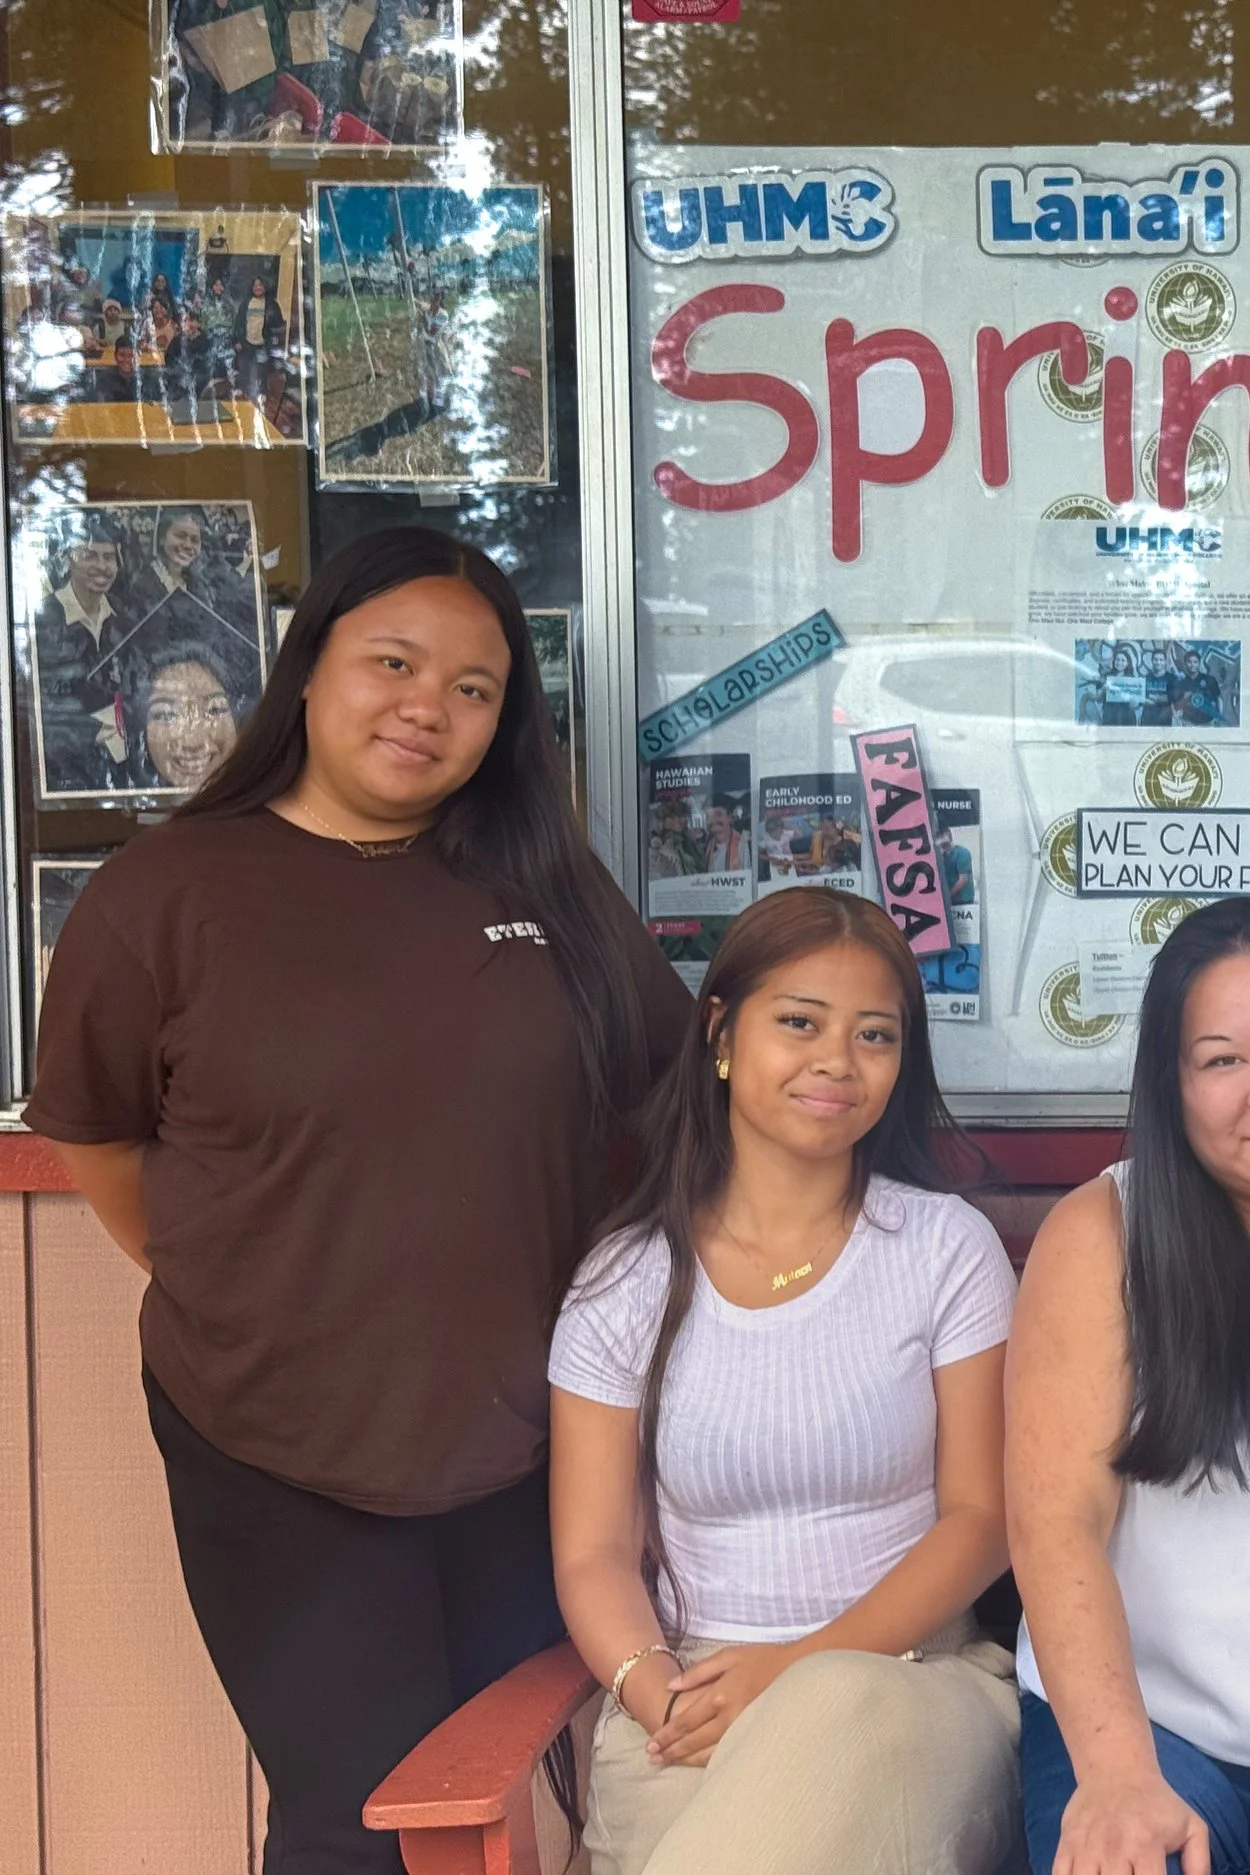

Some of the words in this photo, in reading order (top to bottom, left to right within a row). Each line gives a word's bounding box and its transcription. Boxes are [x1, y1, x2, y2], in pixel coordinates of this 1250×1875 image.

[643, 180, 888, 250] UHMC
[1095, 526, 1223, 552] UHMC
[655, 765, 714, 781] HAWAIIAN
[655, 777, 701, 790] STUDIES
[765, 787, 800, 798] EARLY
[765, 795, 833, 808] CHILDHOOD
[835, 794, 852, 805] ED
[937, 800, 972, 811] NURSE
[865, 736, 941, 942] FAFSA
[1087, 820, 1148, 856] WE
[1159, 822, 1240, 857] CAN
[710, 876, 746, 887] HWST
[823, 877, 855, 888] ECED
[1084, 863, 1151, 888] PLAN
[1159, 863, 1233, 889] YOUR
[483, 921, 545, 943] ETER
